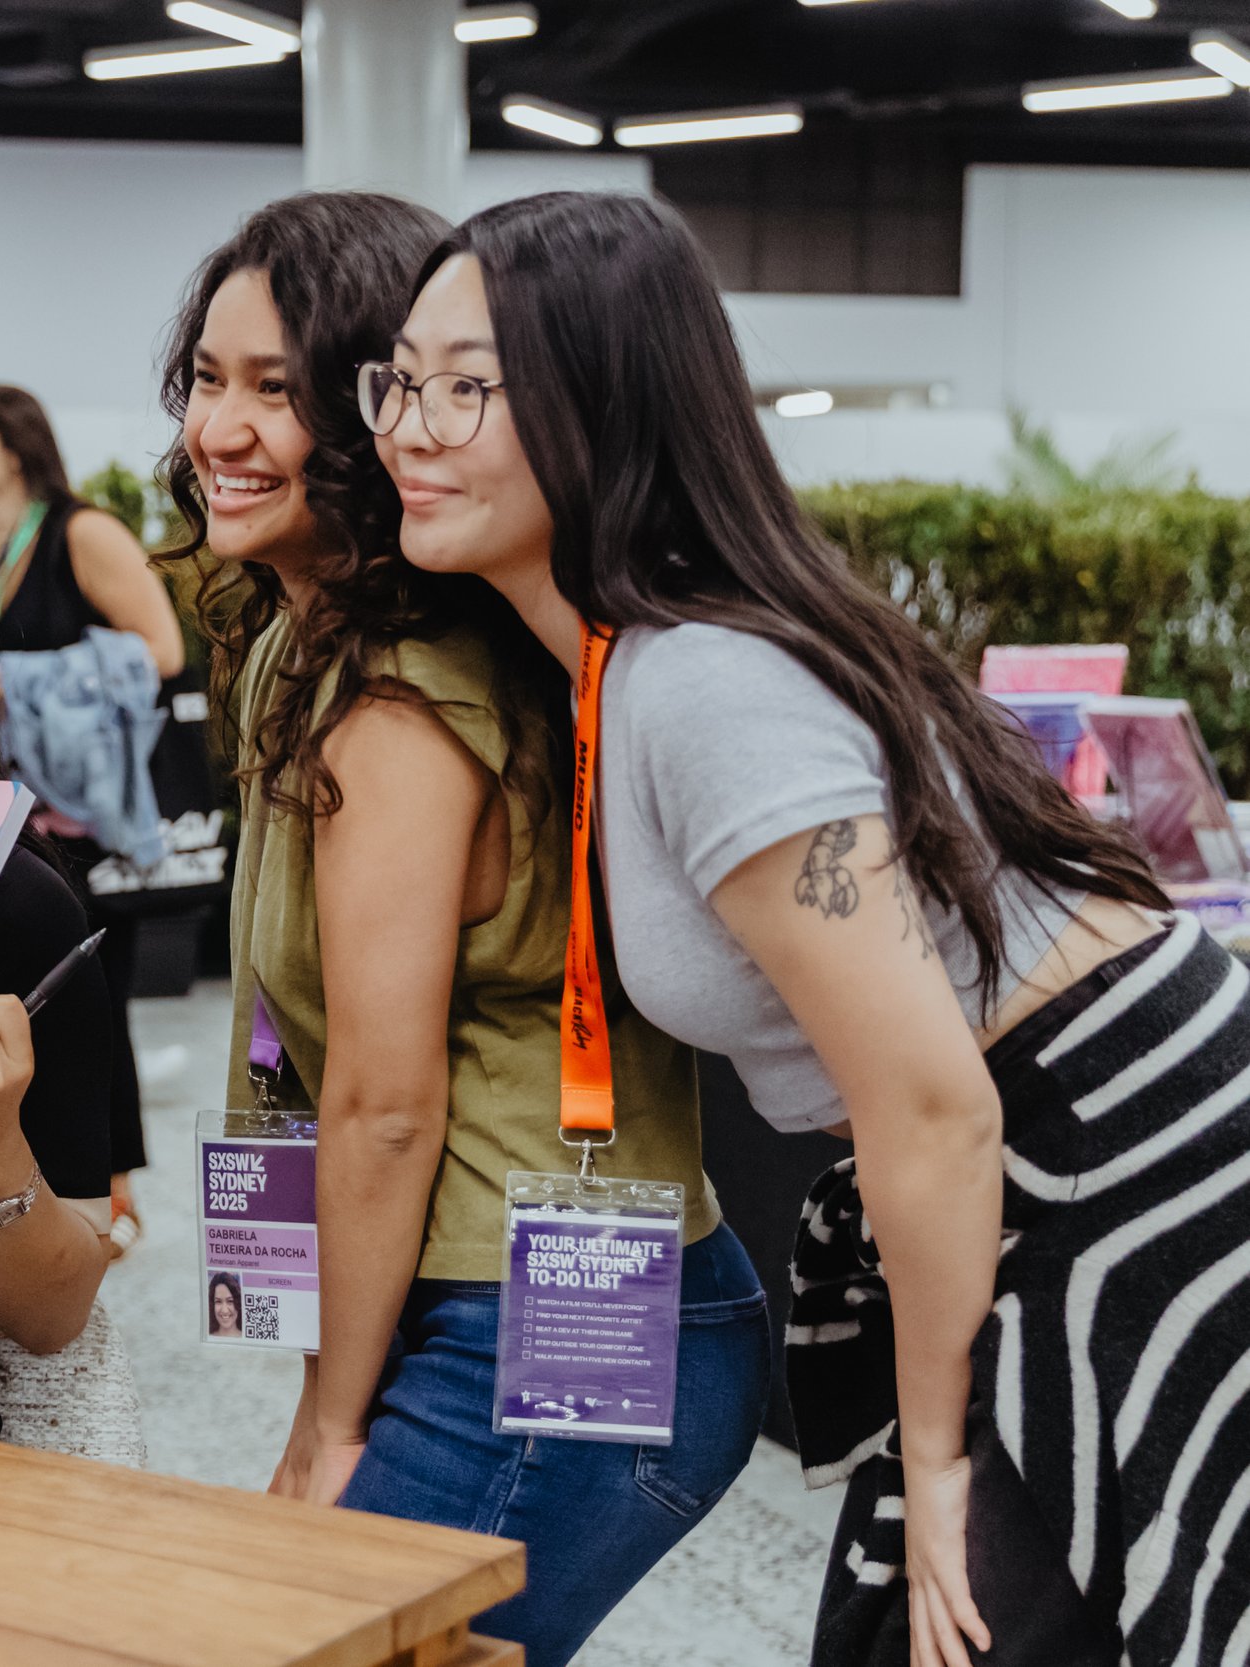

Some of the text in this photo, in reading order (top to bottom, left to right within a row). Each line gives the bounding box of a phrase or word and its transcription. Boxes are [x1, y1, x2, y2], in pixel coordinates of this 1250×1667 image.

[574, 739, 588, 832] MUSIC
[572, 986, 584, 1022] BLACK
[208, 1151, 250, 1171] SXSW
[208, 1171, 268, 1192] SYDNEY
[209, 1192, 248, 1212] 2025
[208, 1228, 257, 1241] GABRIELA
[209, 1243, 307, 1259] TEIXEIRA DA ROCHA
[528, 1233, 663, 1258] YOUR ULTIMATE
[209, 1257, 236, 1266] American
[527, 1251, 649, 1274] SXSW SYDNEY
[268, 1278, 292, 1286] SCREEN
[526, 1268, 622, 1290] TO-DO LIST
[537, 1298, 560, 1306] WATCH
[623, 1304, 648, 1312] FORGET
